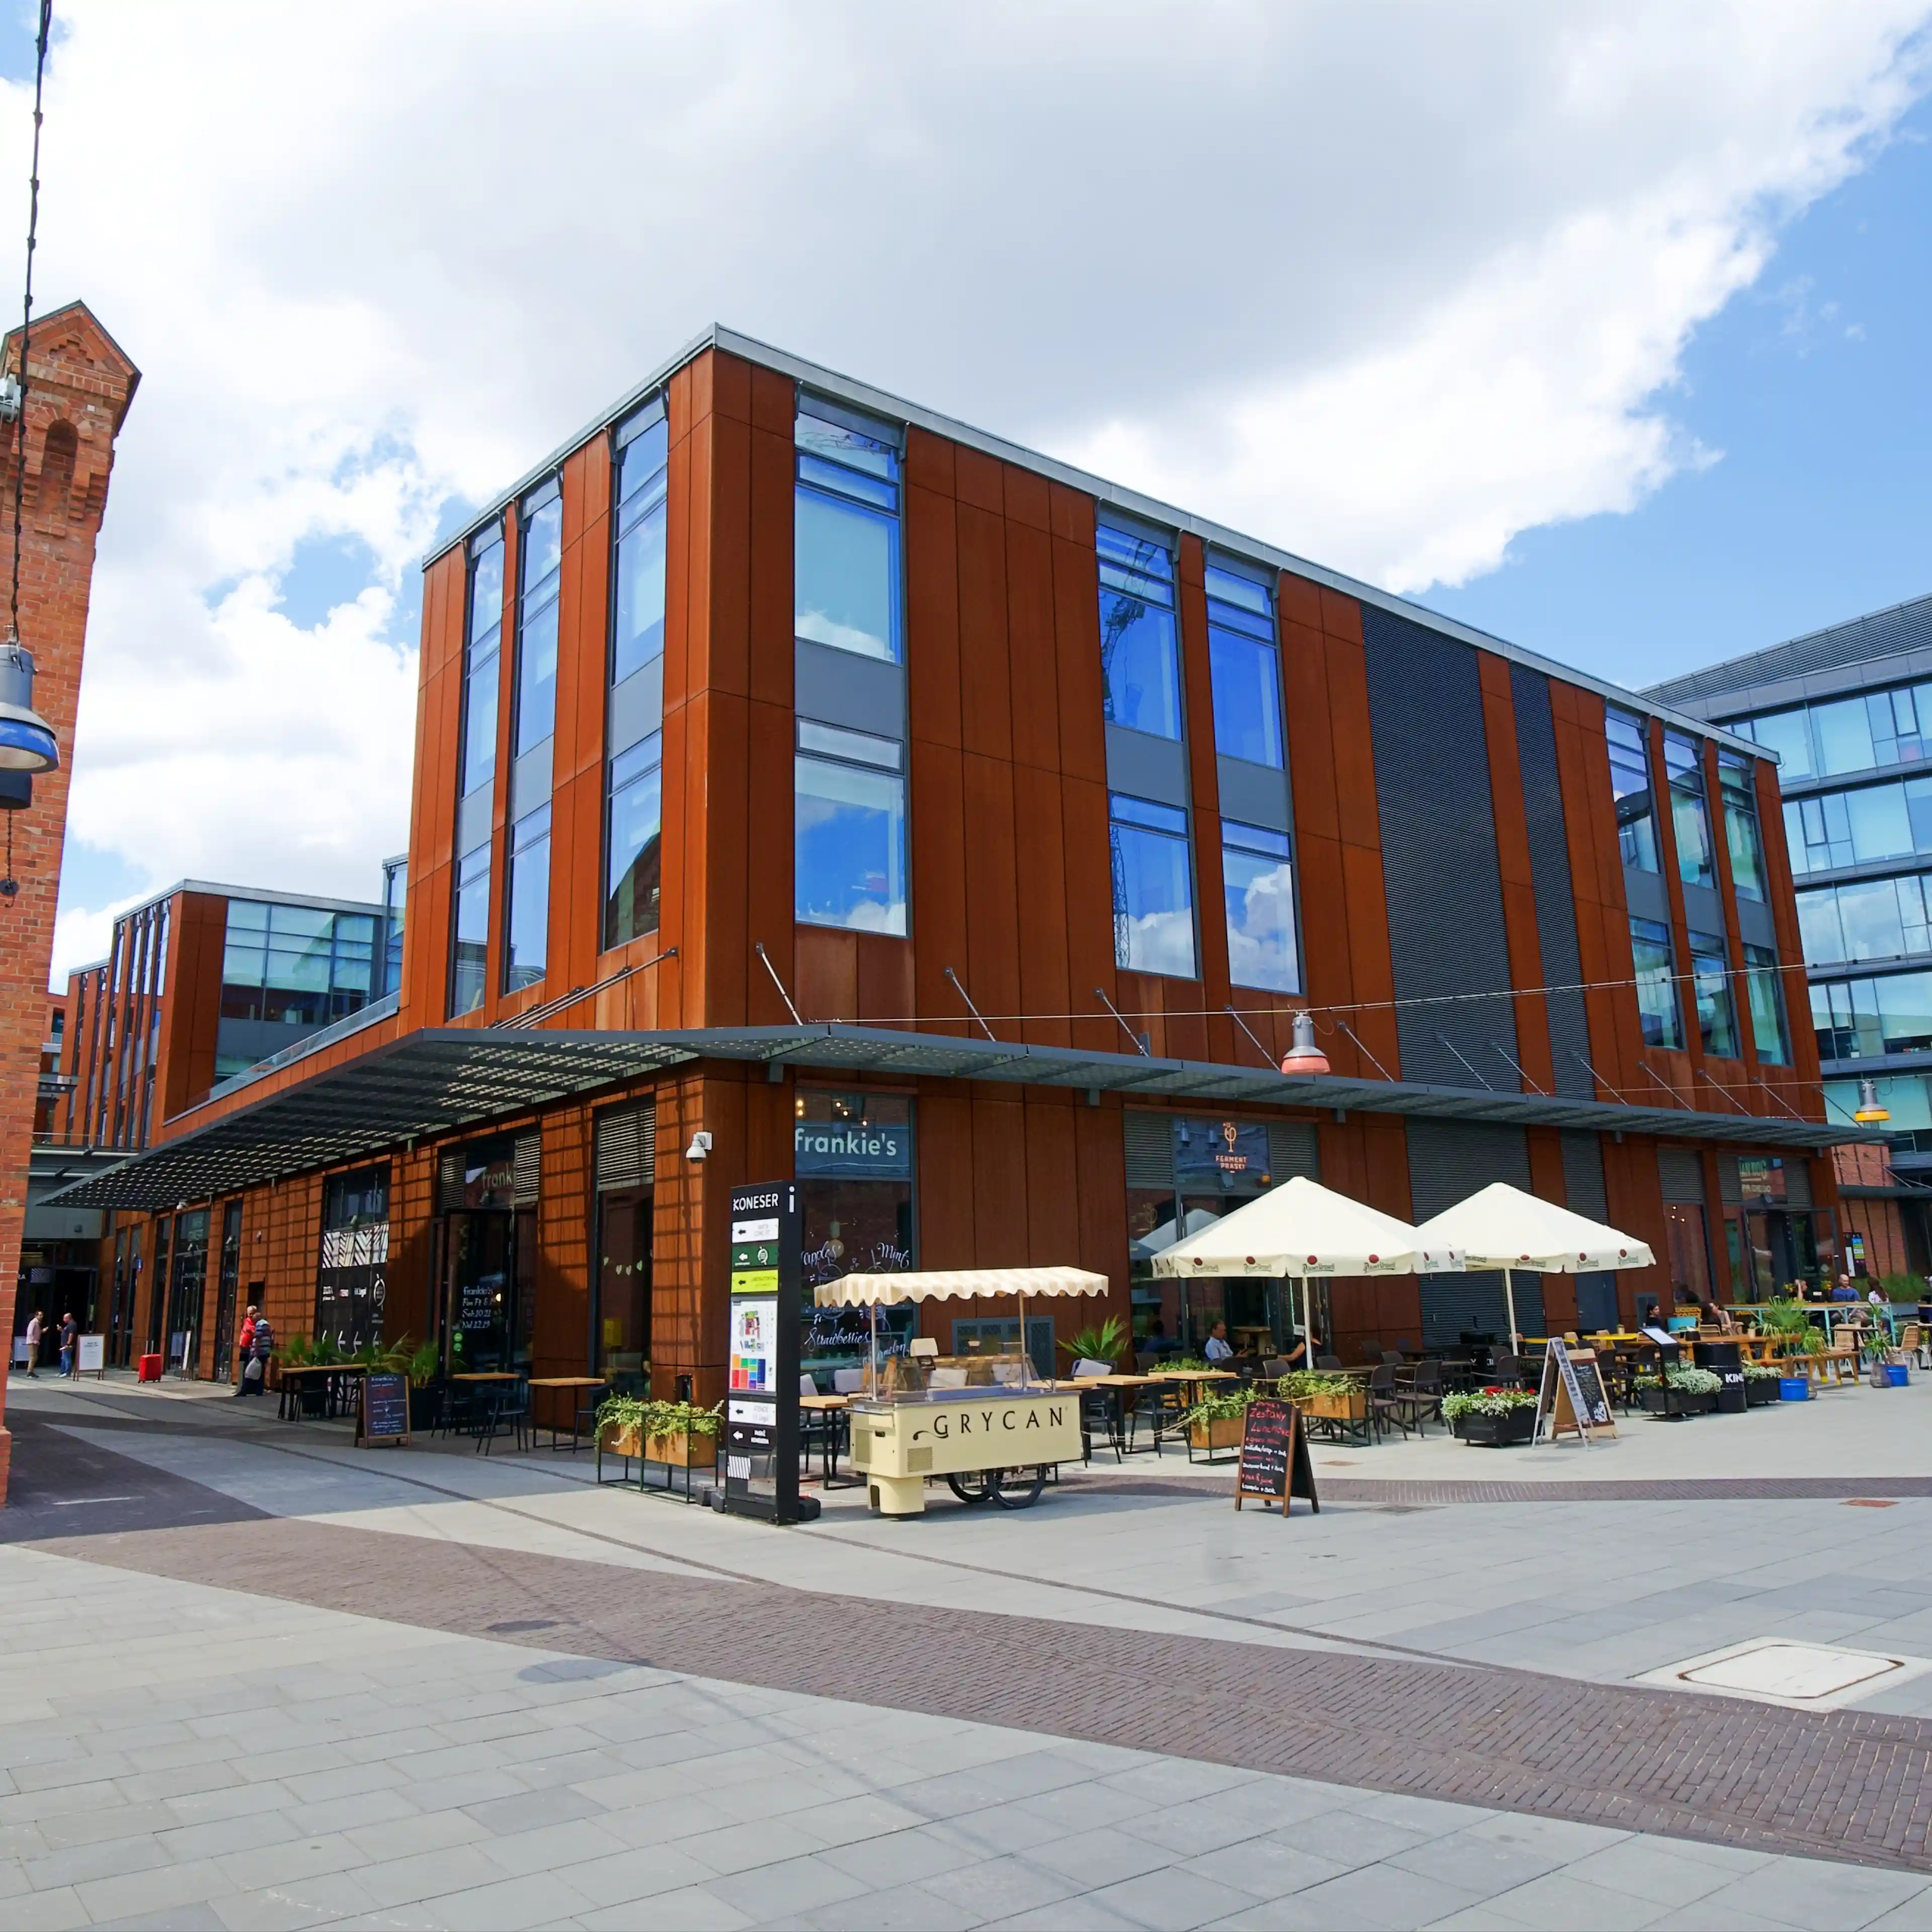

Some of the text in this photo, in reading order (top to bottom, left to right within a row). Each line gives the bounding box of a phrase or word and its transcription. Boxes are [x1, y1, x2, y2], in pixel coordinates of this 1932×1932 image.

[795, 1128, 897, 1156] frankie's
[733, 1193, 778, 1212] KONESER
[877, 1242, 909, 1268] Mint
[804, 1327, 871, 1351] Strawberries
[933, 1407, 1062, 1438] GRYCAN
[1250, 1408, 1287, 1421] Zestawy
